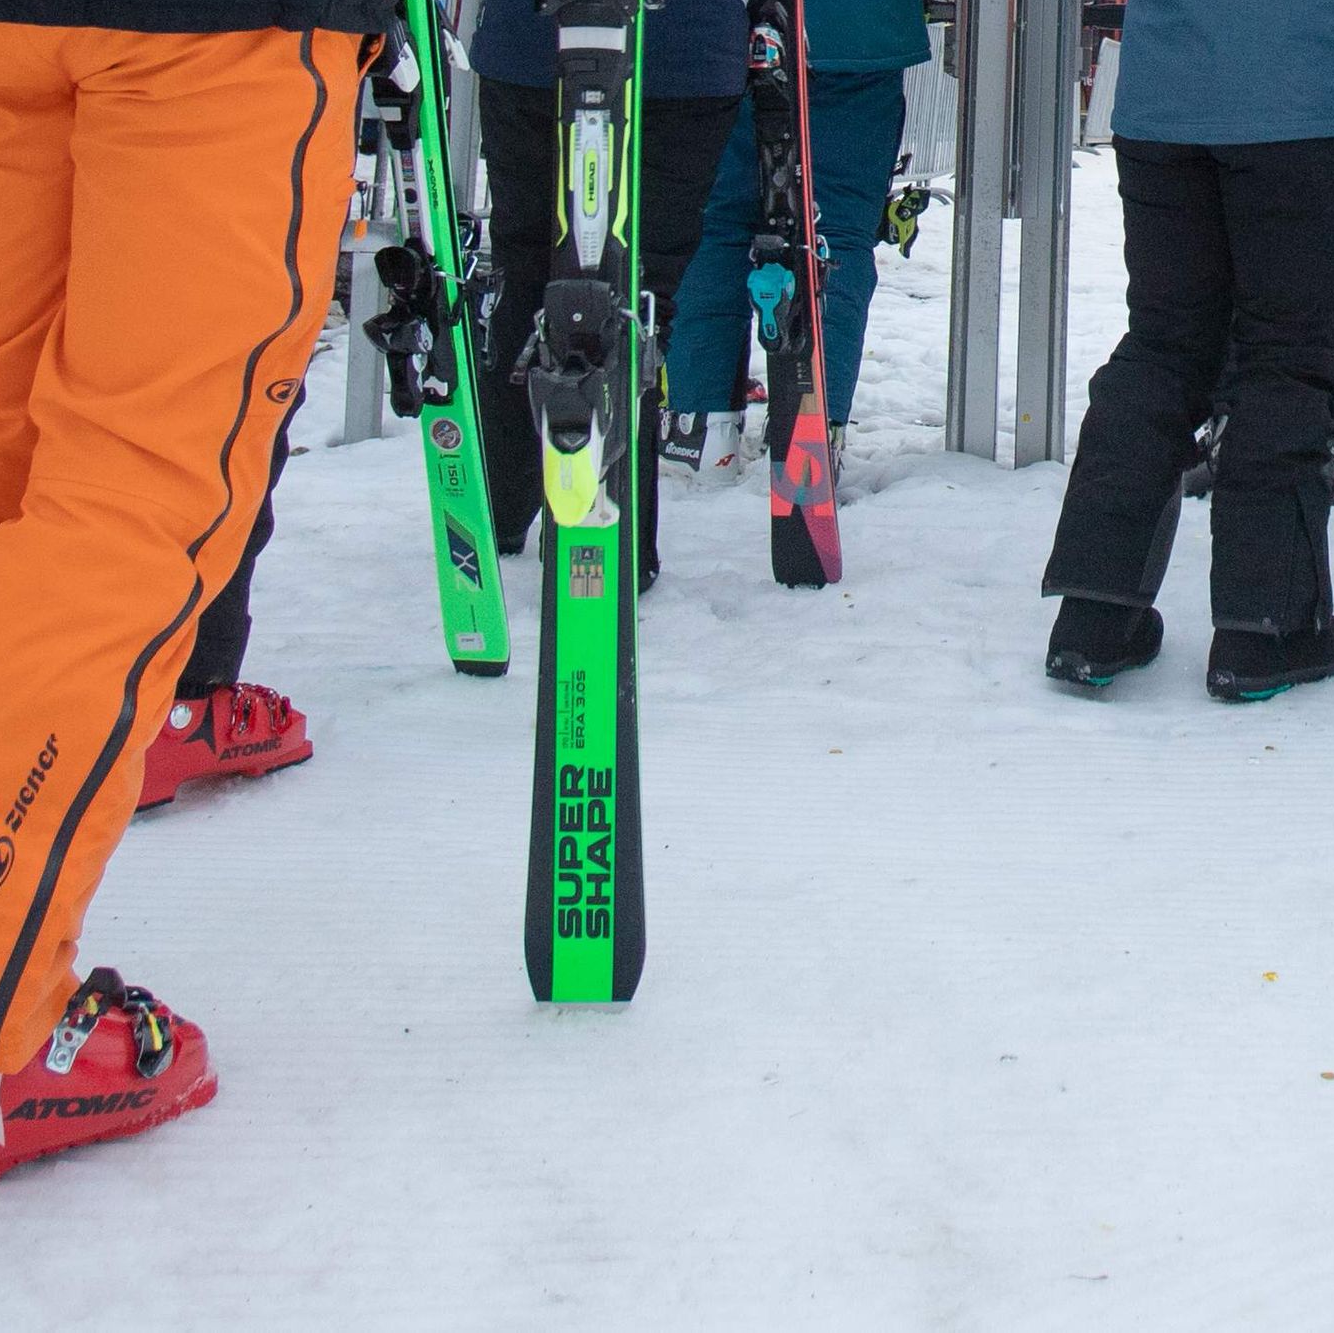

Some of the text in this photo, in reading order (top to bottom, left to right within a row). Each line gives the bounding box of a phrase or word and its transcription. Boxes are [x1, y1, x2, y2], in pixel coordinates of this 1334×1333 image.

[218, 737, 283, 762] ATOMIC
[575, 712, 585, 749] ERA
[5, 732, 62, 835] ziener
[558, 763, 585, 938] SUPER
[585, 767, 612, 939] SHAPE
[5, 1087, 159, 1122] ATOMIC
